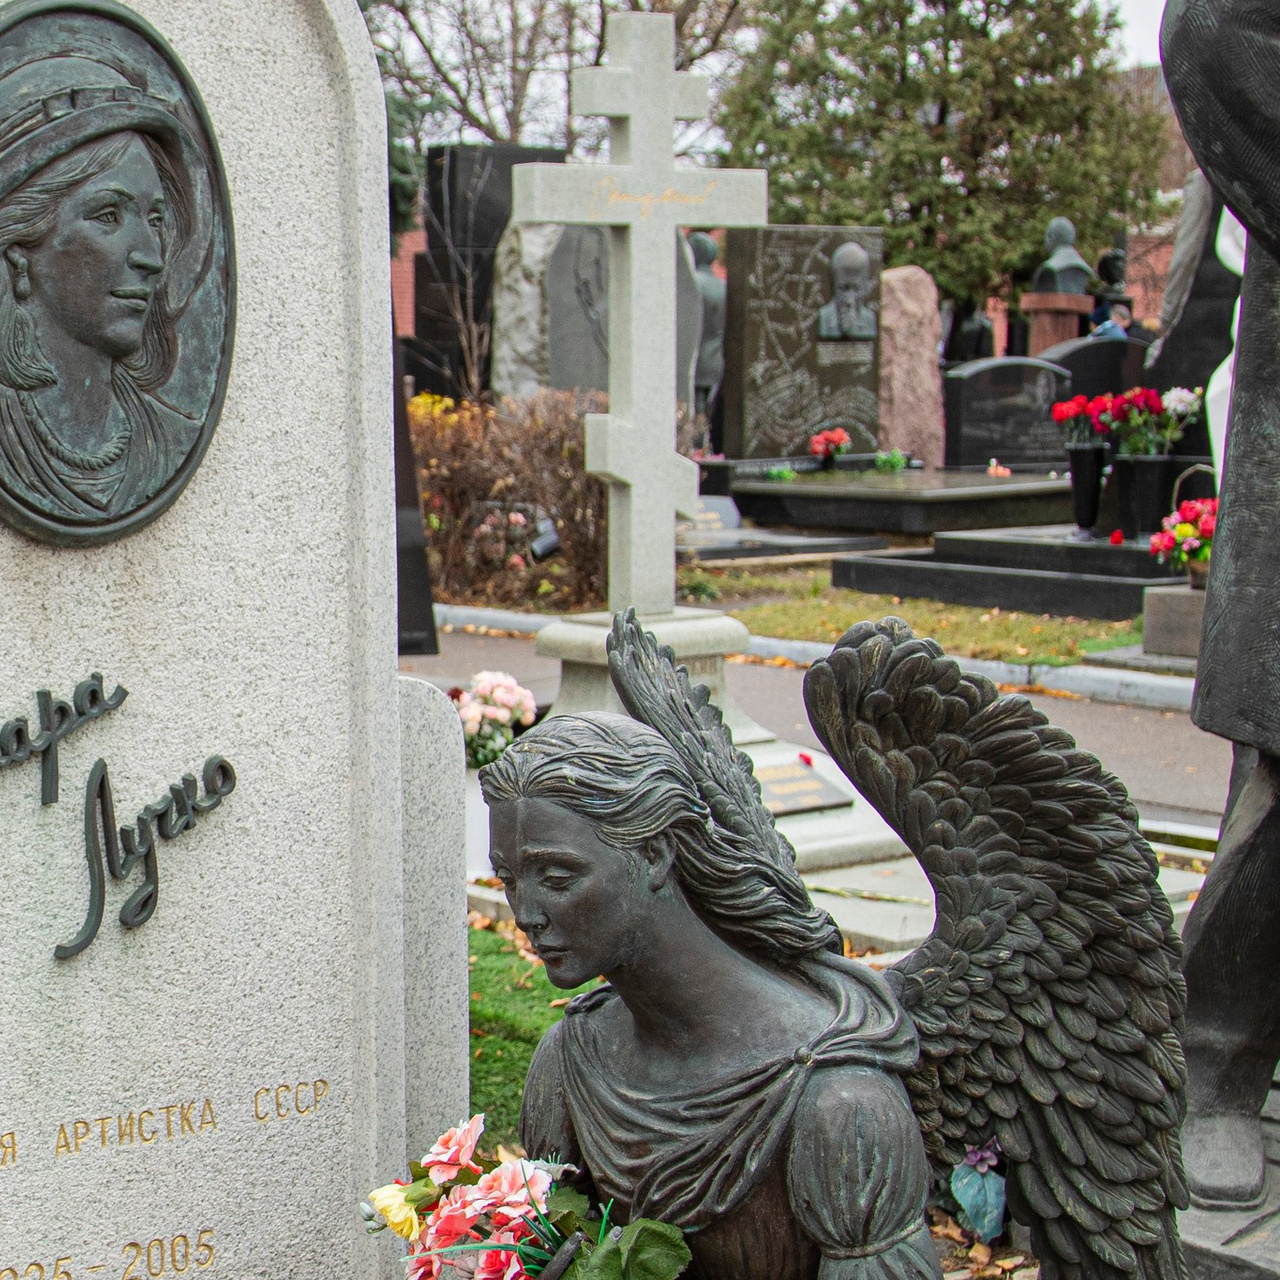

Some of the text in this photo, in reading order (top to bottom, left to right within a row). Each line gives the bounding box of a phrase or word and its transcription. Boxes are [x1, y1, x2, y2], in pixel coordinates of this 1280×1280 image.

[53, 752, 237, 960] Лучко
[54, 1097, 218, 1160] АРТИСТКА
[253, 1078, 330, 1123] СССР
